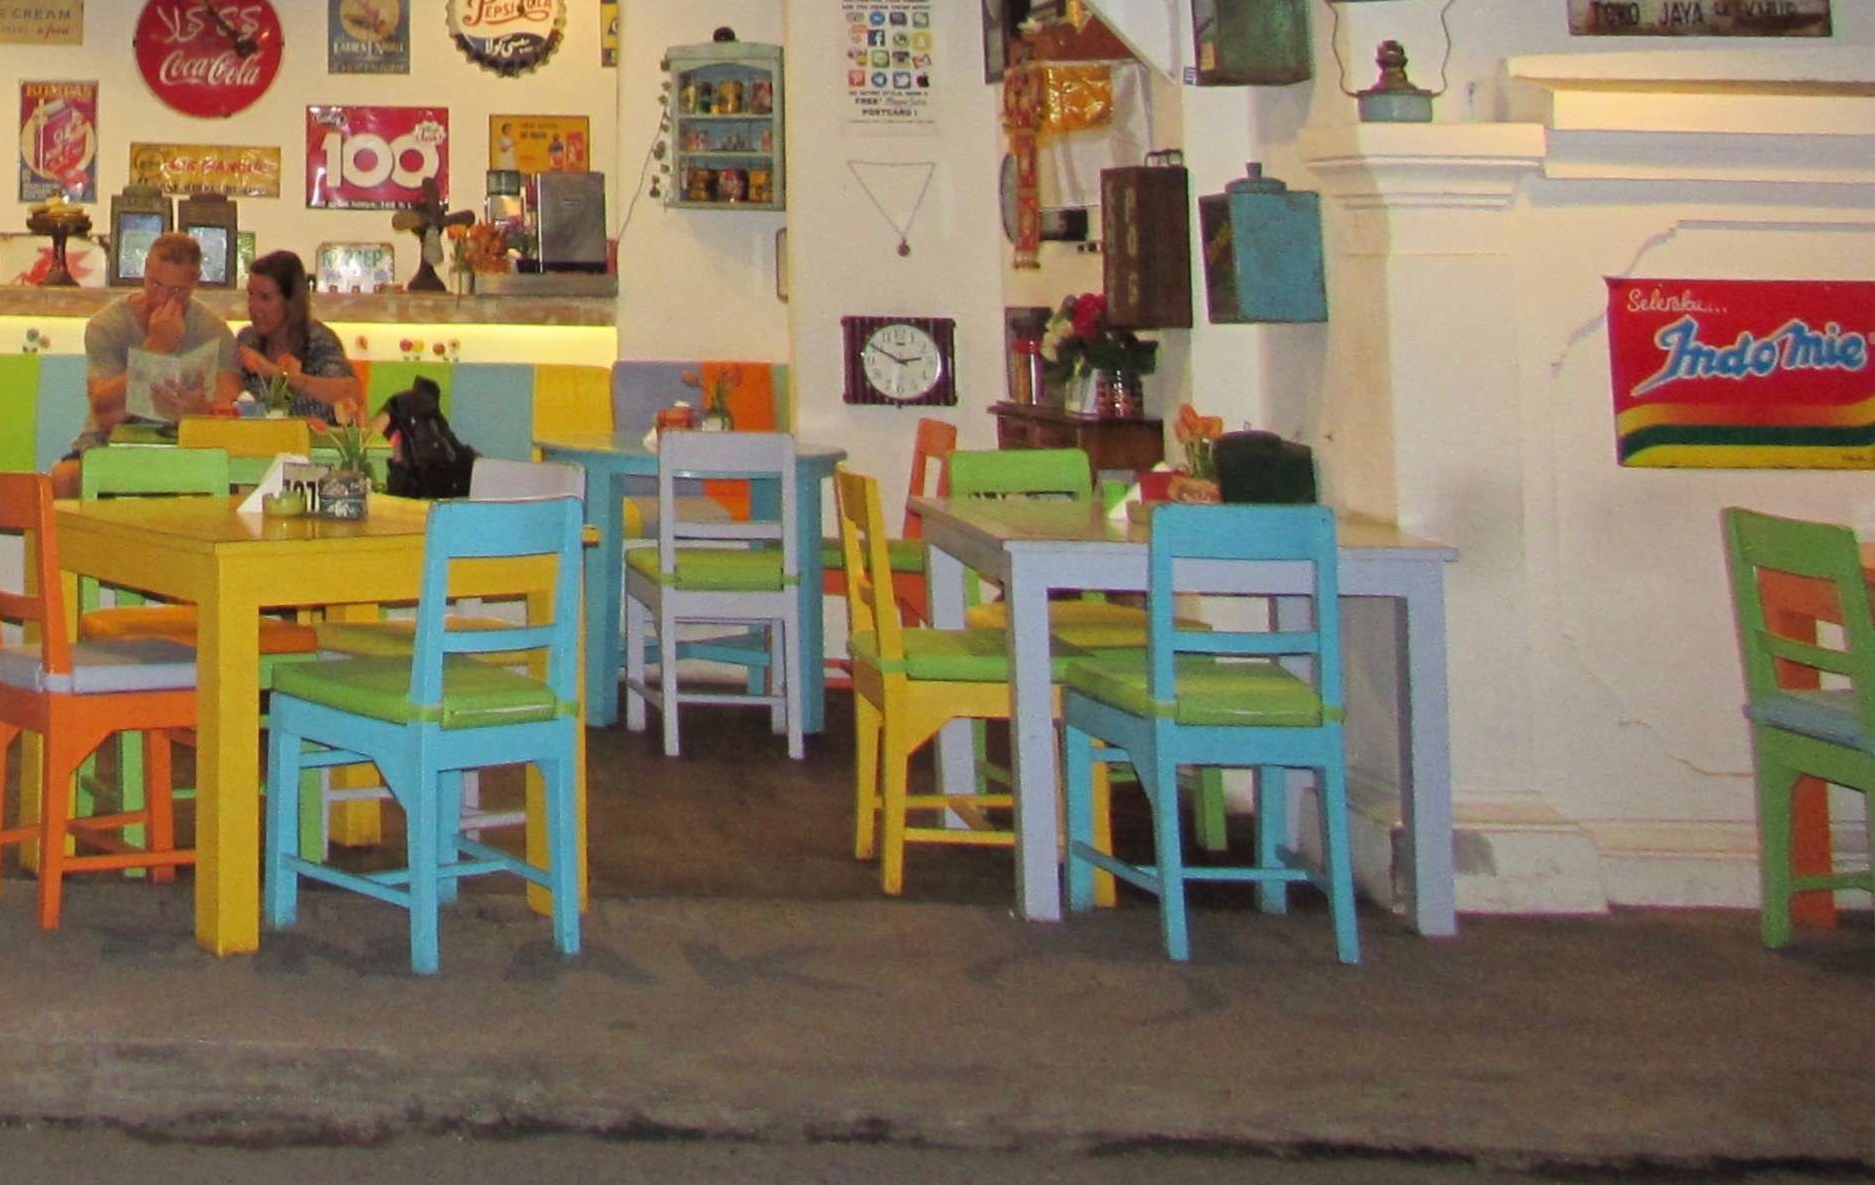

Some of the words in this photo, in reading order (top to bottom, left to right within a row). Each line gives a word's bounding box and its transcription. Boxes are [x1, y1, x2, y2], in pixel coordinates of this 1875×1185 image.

[11, 7, 71, 20] CREAM
[1659, 1, 1704, 24] JAYA
[321, 132, 440, 189] 100
